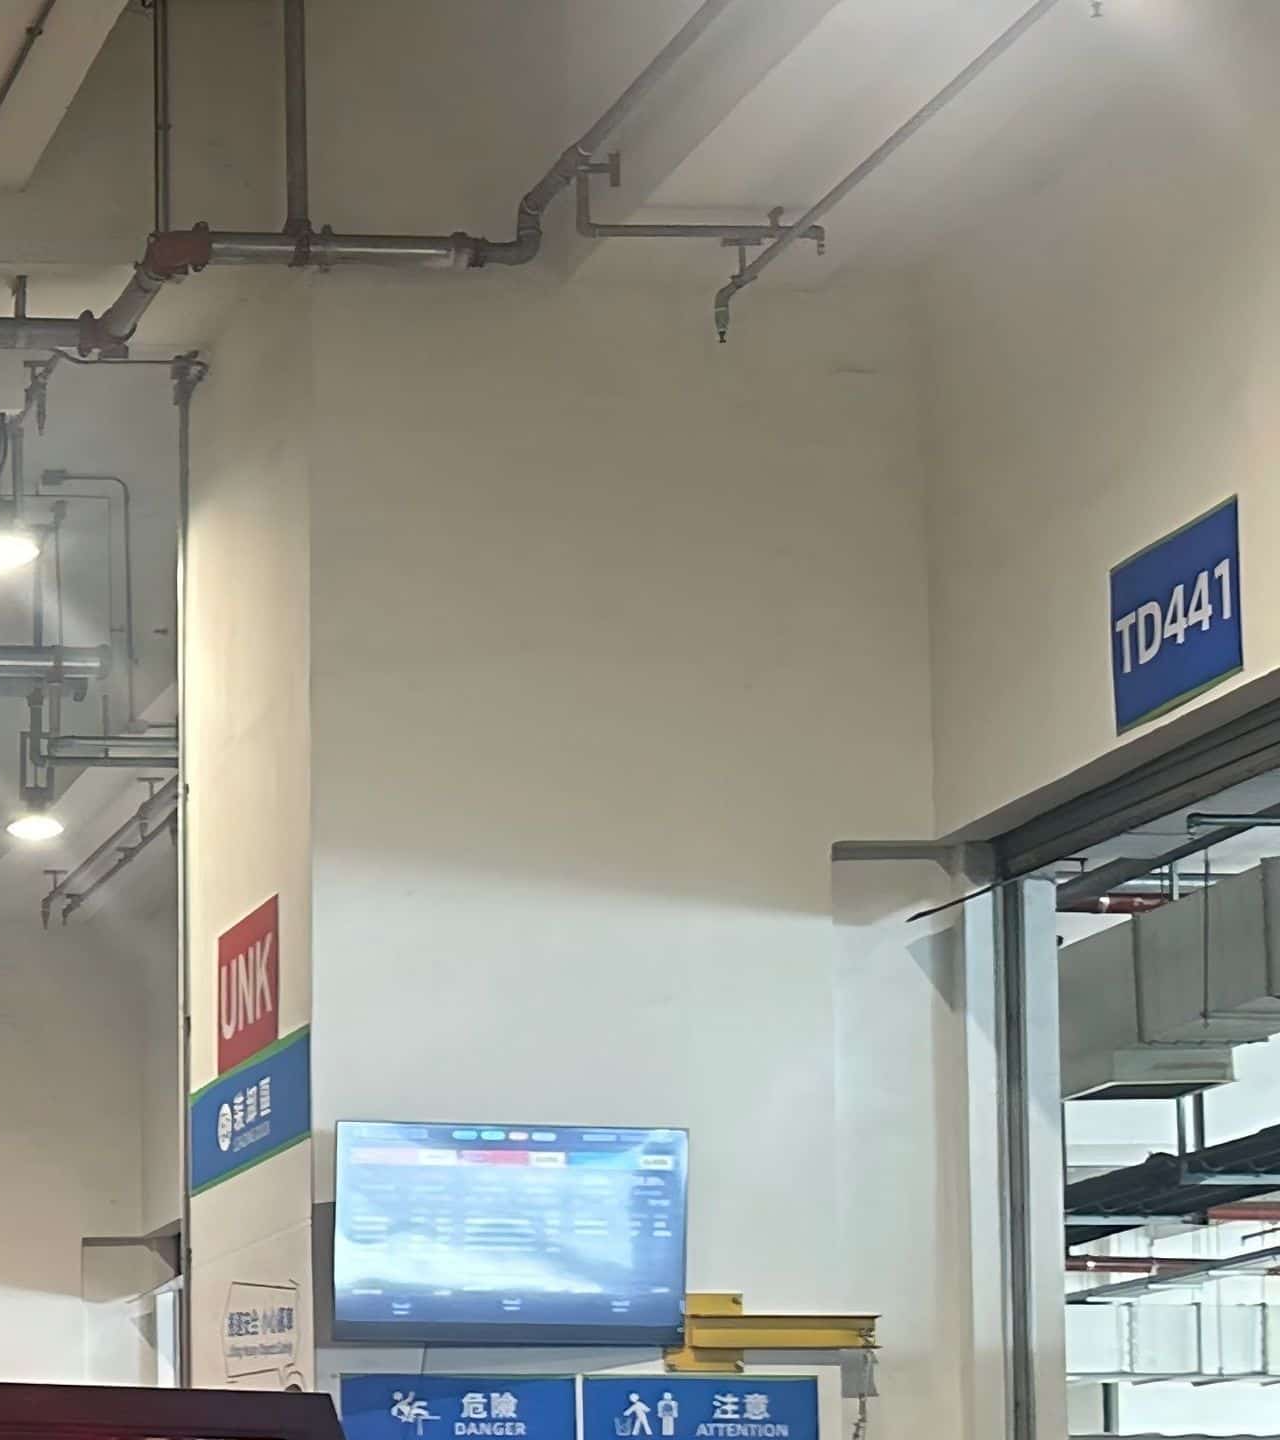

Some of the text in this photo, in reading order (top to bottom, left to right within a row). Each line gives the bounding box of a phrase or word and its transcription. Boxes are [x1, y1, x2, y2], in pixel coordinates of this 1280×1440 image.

[1116, 558, 1231, 674] TD441
[221, 931, 272, 1040] UNK
[712, 1393, 770, 1420] 注意
[454, 1422, 527, 1436] DANGER
[696, 1423, 789, 1437] ATTENTION
